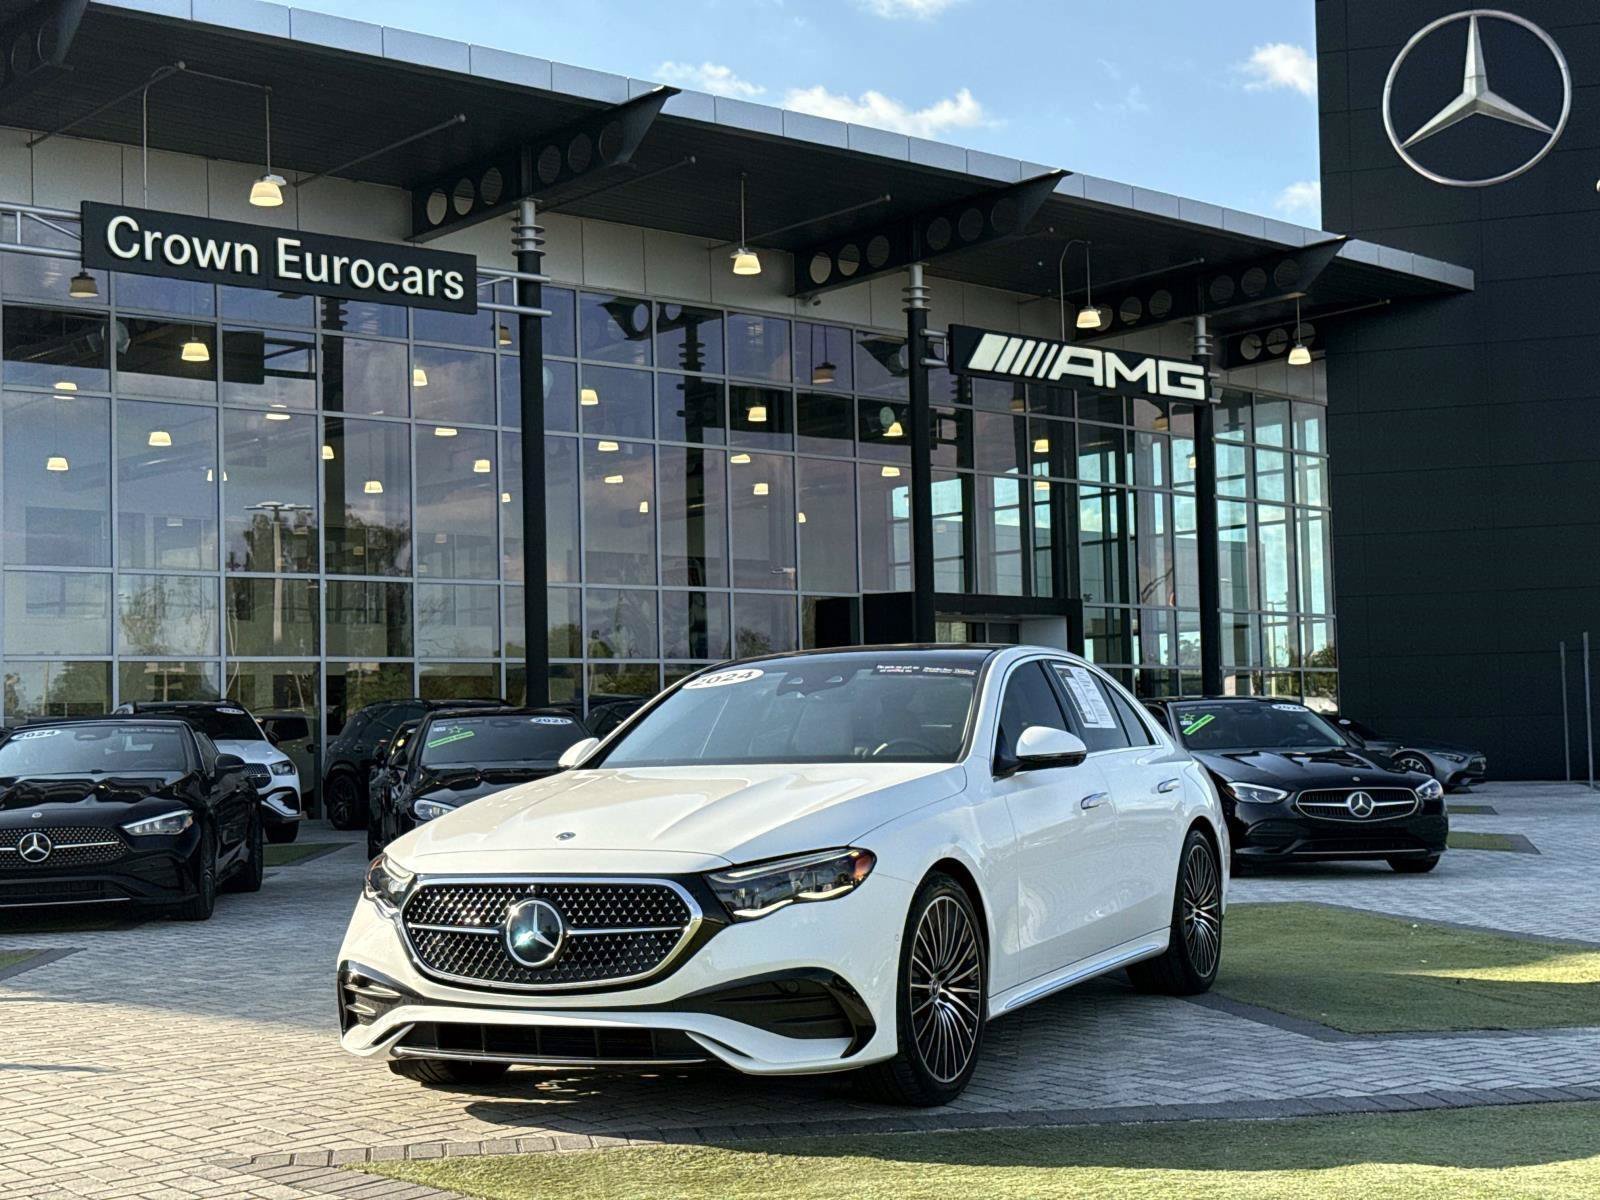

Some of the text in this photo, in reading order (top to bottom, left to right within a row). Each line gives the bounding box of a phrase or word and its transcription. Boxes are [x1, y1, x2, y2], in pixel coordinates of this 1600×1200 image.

[107, 215, 464, 300] Crown Eurocars
[1047, 345, 1205, 400] AMG
[689, 670, 755, 687] 2024
[17, 730, 56, 739] 2024
